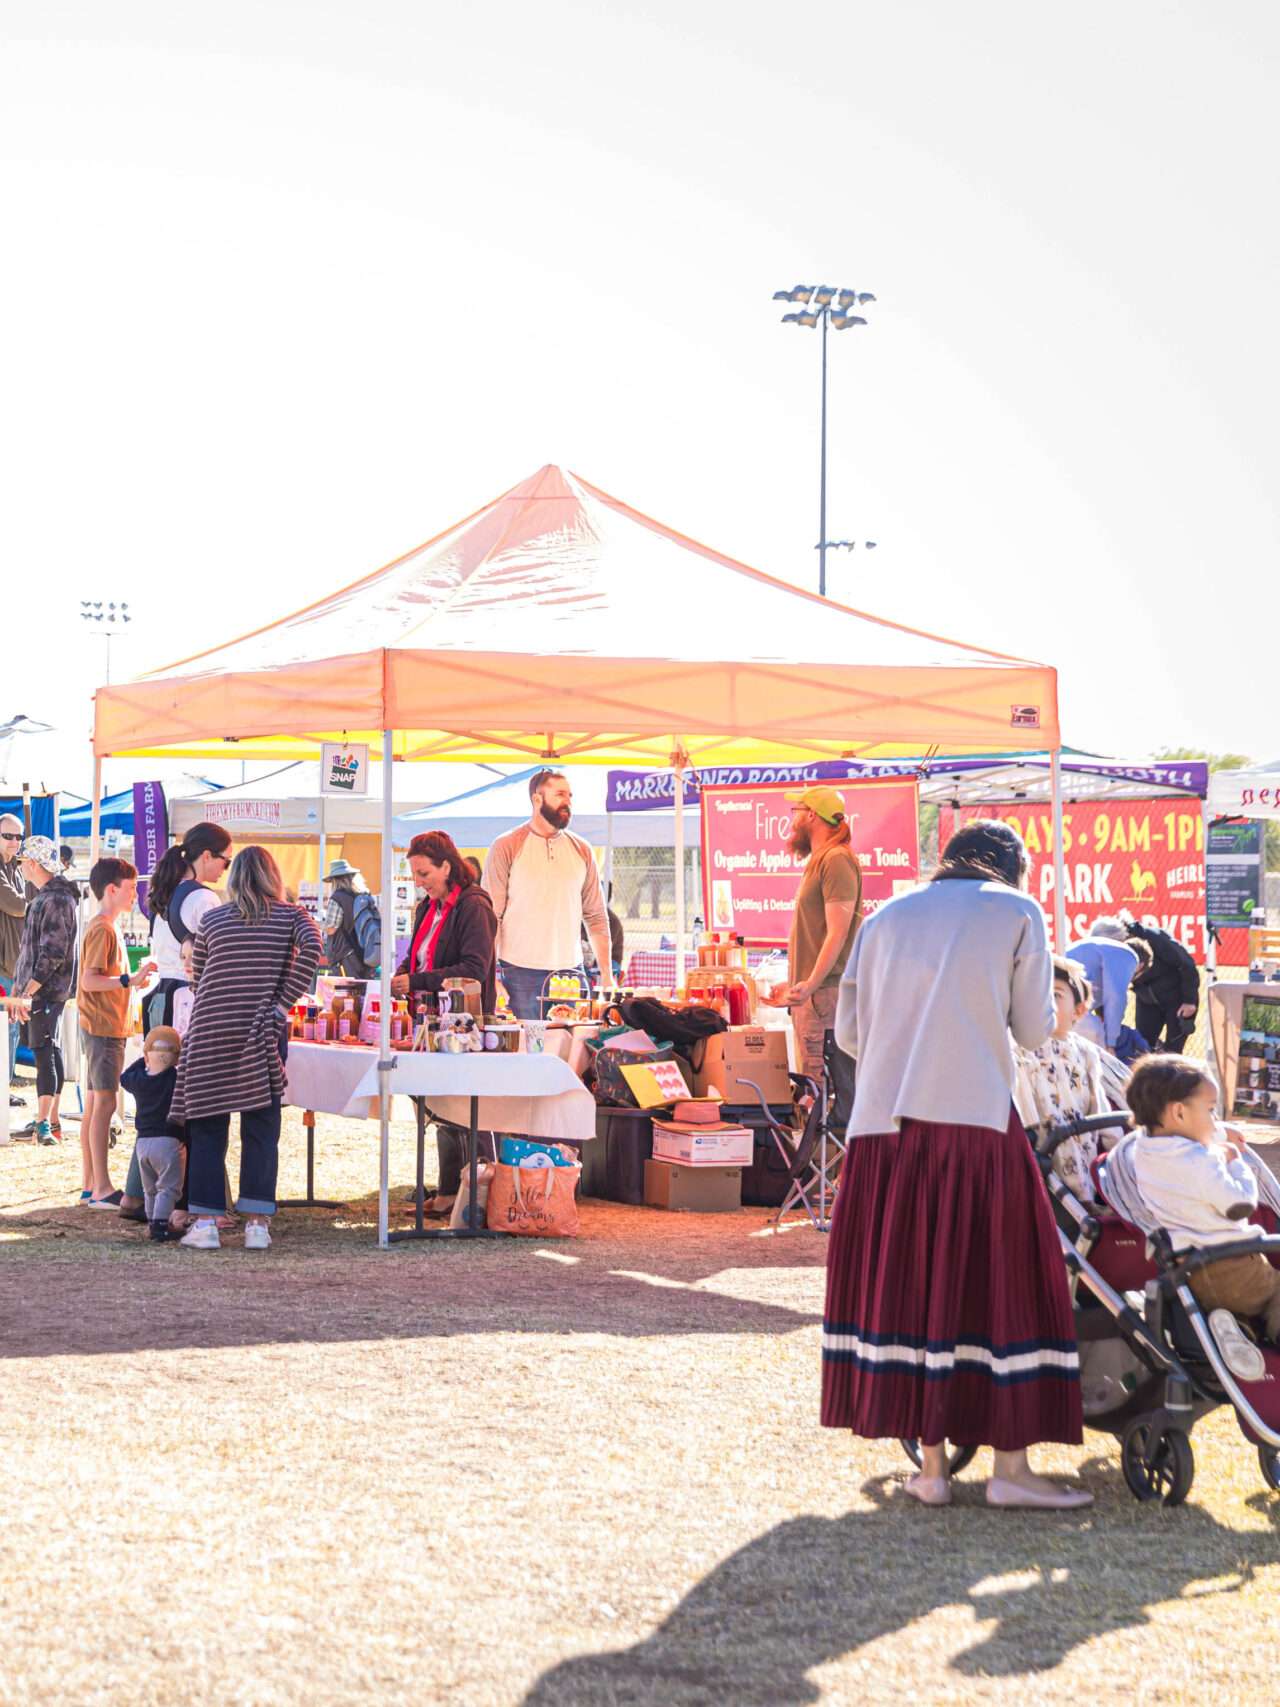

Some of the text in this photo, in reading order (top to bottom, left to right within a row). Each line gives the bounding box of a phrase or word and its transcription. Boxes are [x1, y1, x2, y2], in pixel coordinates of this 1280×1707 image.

[330, 772, 356, 783] SNAP
[146, 828, 158, 874] NDER
[714, 850, 757, 872] Organic
[759, 849, 791, 873] Apple
[873, 847, 910, 868] Tonic
[1039, 863, 1114, 904] PARK
[1166, 863, 1206, 888] HEIRL
[733, 898, 762, 912] Uplifting
[763, 899, 769, 910] &
